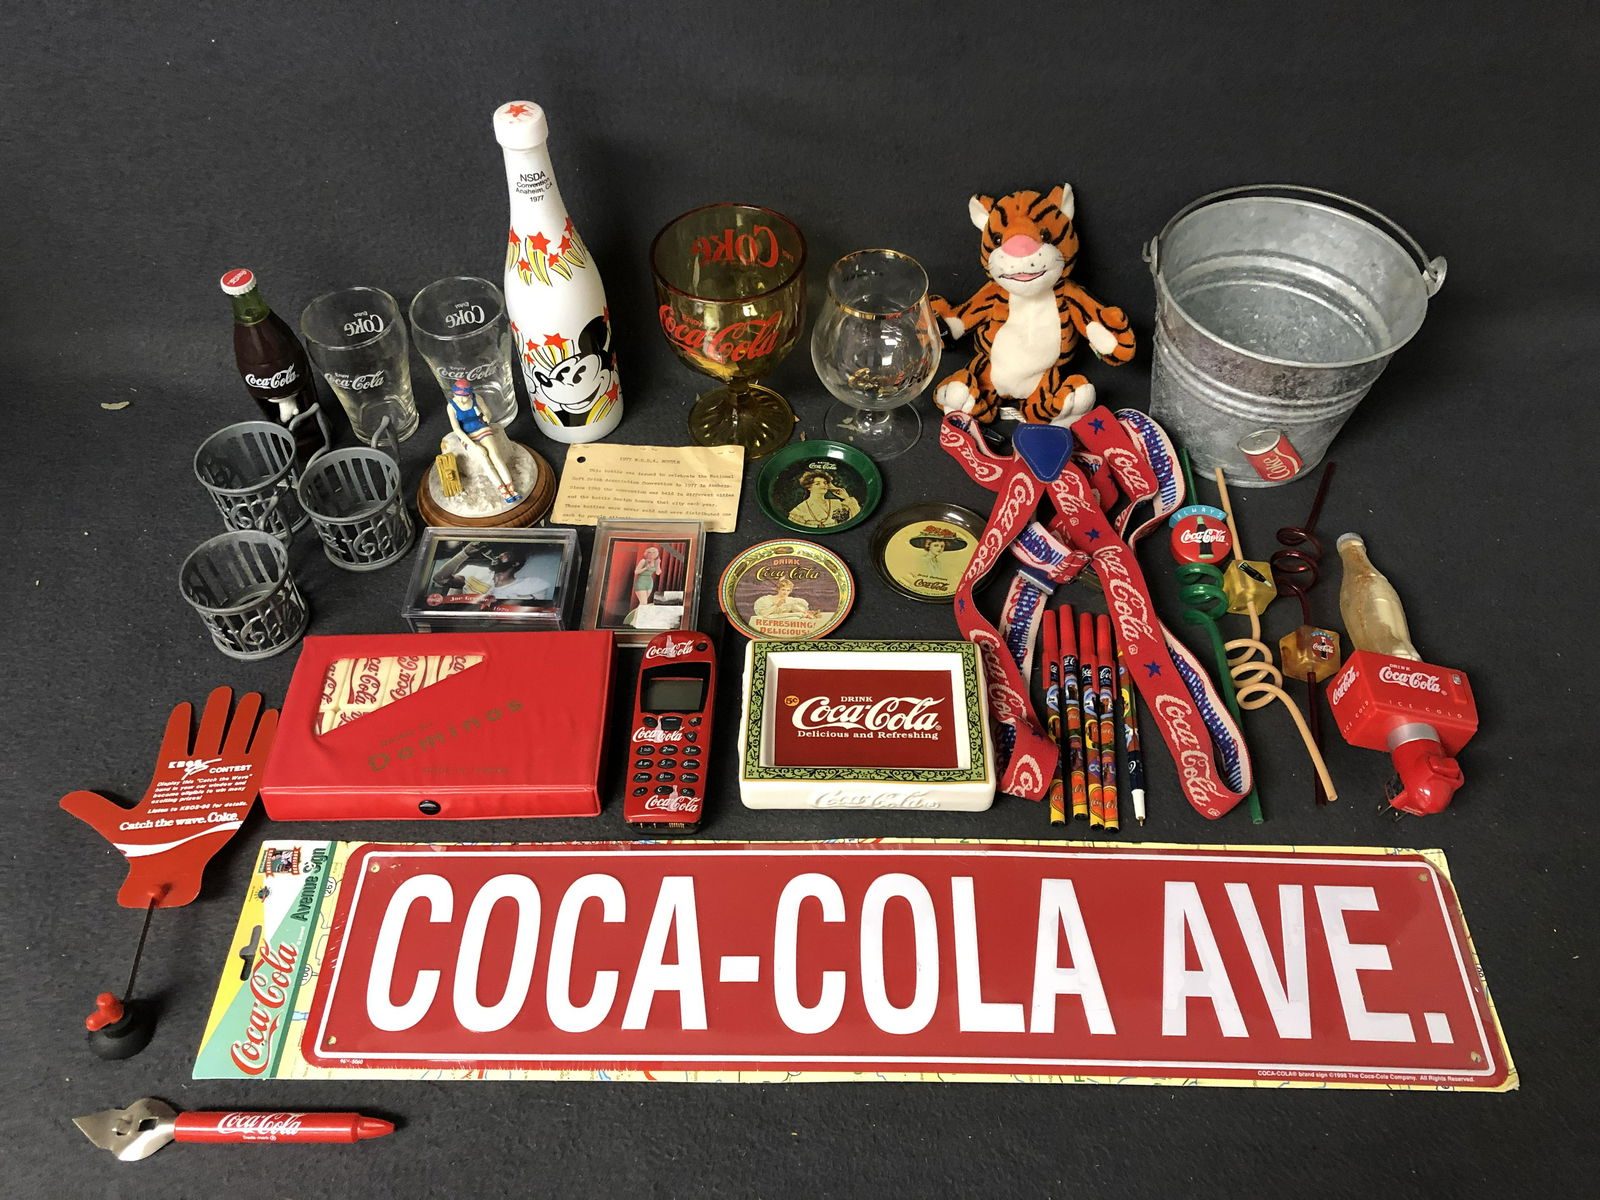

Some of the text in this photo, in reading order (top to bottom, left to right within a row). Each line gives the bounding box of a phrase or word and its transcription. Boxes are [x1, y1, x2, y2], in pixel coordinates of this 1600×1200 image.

[516, 176, 550, 189] Convention
[519, 170, 546, 183] NSDA
[515, 186, 544, 194] Anaheim,
[530, 194, 545, 203] 1977
[659, 304, 783, 364] Coca-Cola
[244, 362, 299, 389] Coca-Cola
[324, 369, 385, 391] Coca-Cola
[1262, 455, 1292, 481] Coke
[1180, 528, 1227, 544] Coca-Cola
[772, 559, 800, 567] DRINK
[913, 578, 950, 592] Coca-Cola
[1092, 544, 1159, 642] Coca-Cola
[755, 618, 816, 629] REFRESHING!
[759, 626, 811, 636] DELICIOUS!
[645, 640, 695, 659] Coca-Cola
[1379, 665, 1442, 693] Coca-Cola
[791, 696, 945, 731] Coca-Cola
[367, 699, 524, 773] Dominos
[632, 726, 684, 743] Coca-Cola
[797, 730, 939, 741] Delicious and Refreshing
[1155, 693, 1229, 807] Coca-Cola
[208, 764, 253, 774] CONTEST
[645, 795, 701, 812] Coca-Cola
[119, 811, 239, 831] Catch the wave. Coke.
[290, 875, 320, 923] Avenue
[366, 872, 1455, 1044] COCA-COLA AVE.
[230, 938, 298, 1076] Coca-Cola
[1389, 1074, 1417, 1082] Company.
[1429, 1075, 1446, 1083] Rights
[217, 1111, 305, 1135] Coca-Cola
